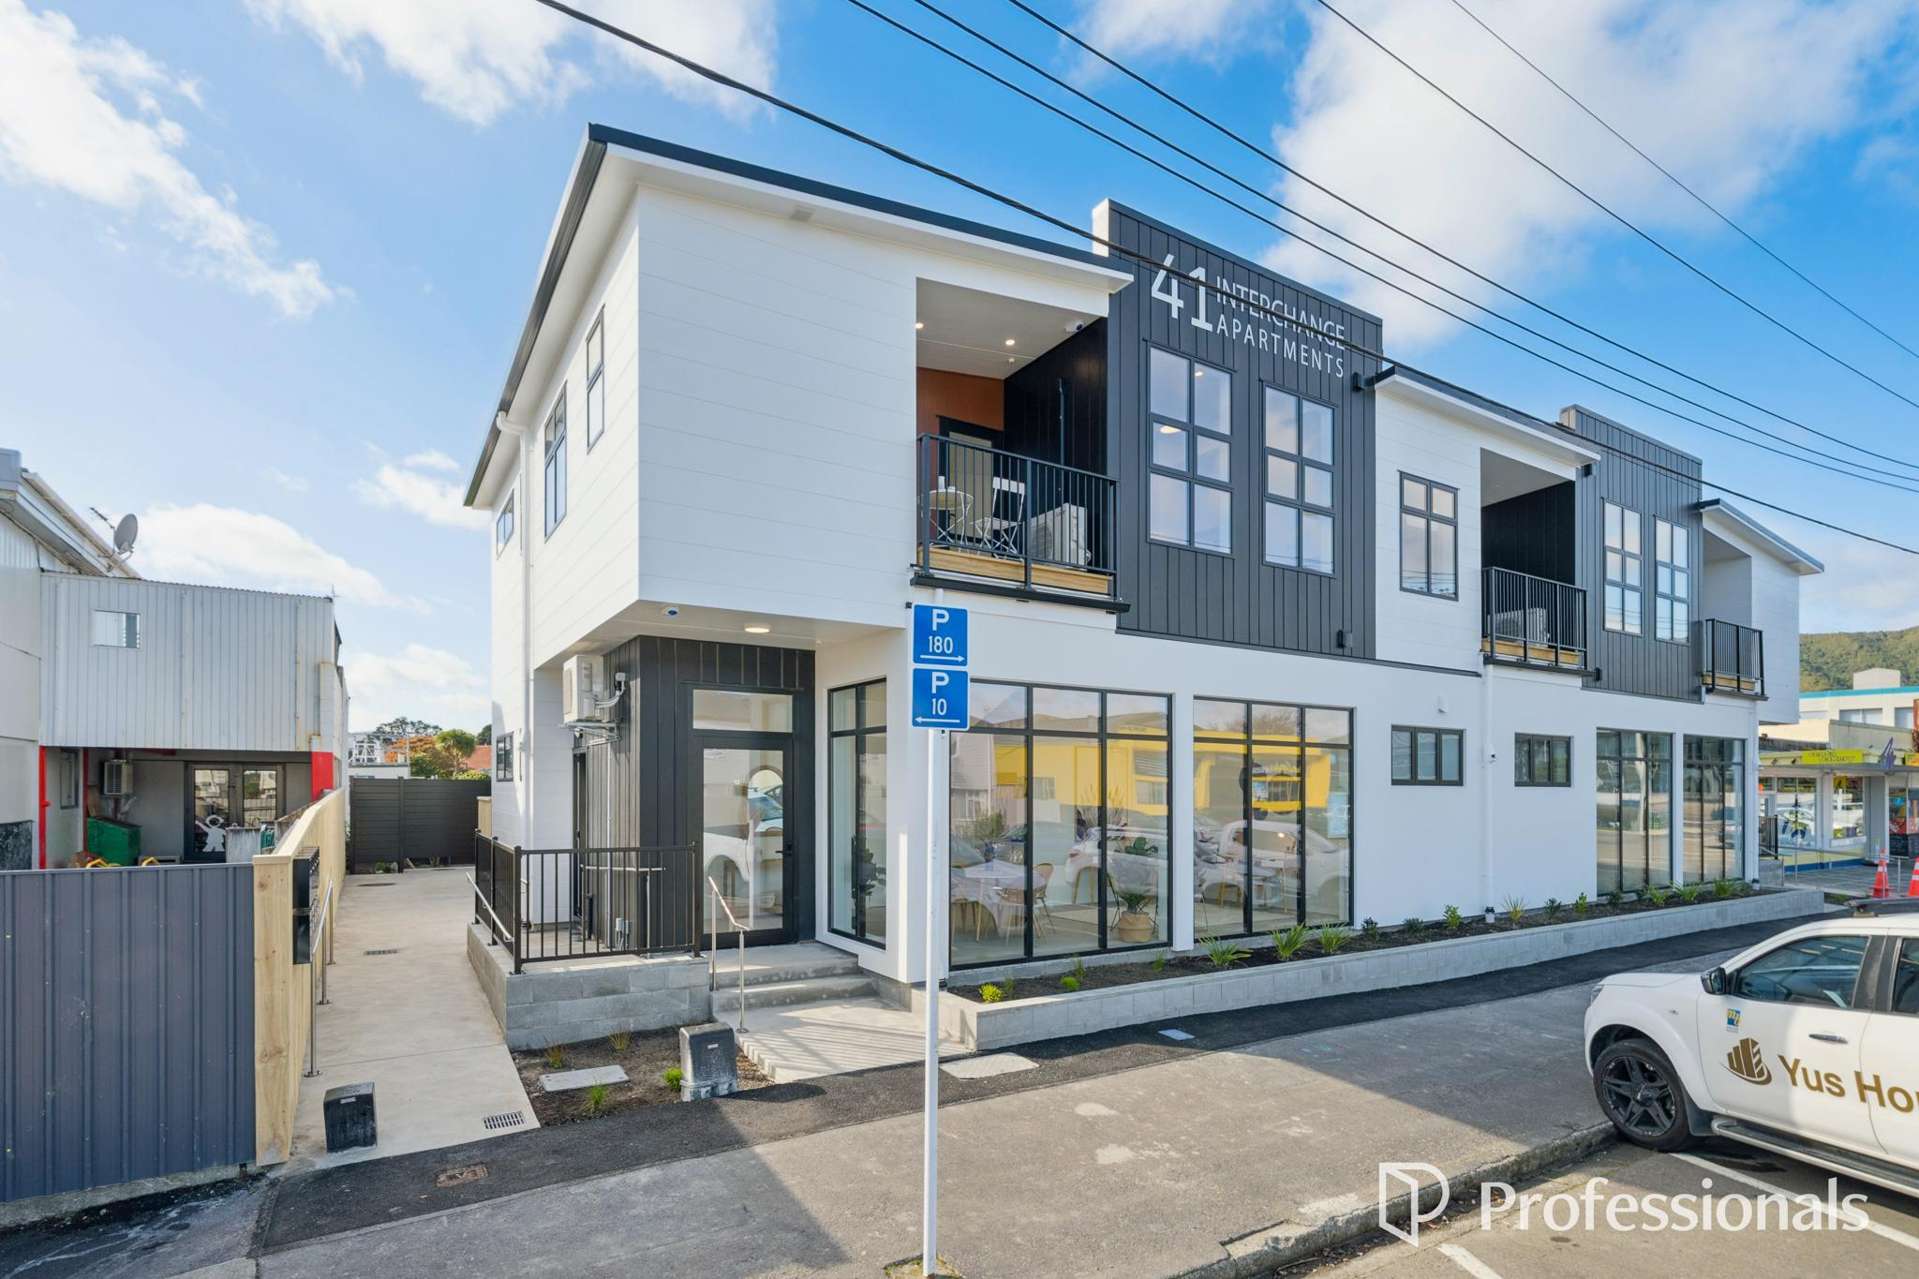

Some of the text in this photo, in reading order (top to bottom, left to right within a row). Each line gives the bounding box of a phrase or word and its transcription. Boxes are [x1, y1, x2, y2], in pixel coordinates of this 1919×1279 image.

[1151, 254, 1213, 332] 41
[1216, 276, 1345, 350] INTERCHANGE
[1216, 314, 1344, 378] APARTMENTS
[932, 608, 950, 631] P
[928, 635, 954, 654] 180
[931, 671, 950, 694] P
[931, 698, 947, 716] 10
[1778, 1054, 1919, 1113] Yus Ho
